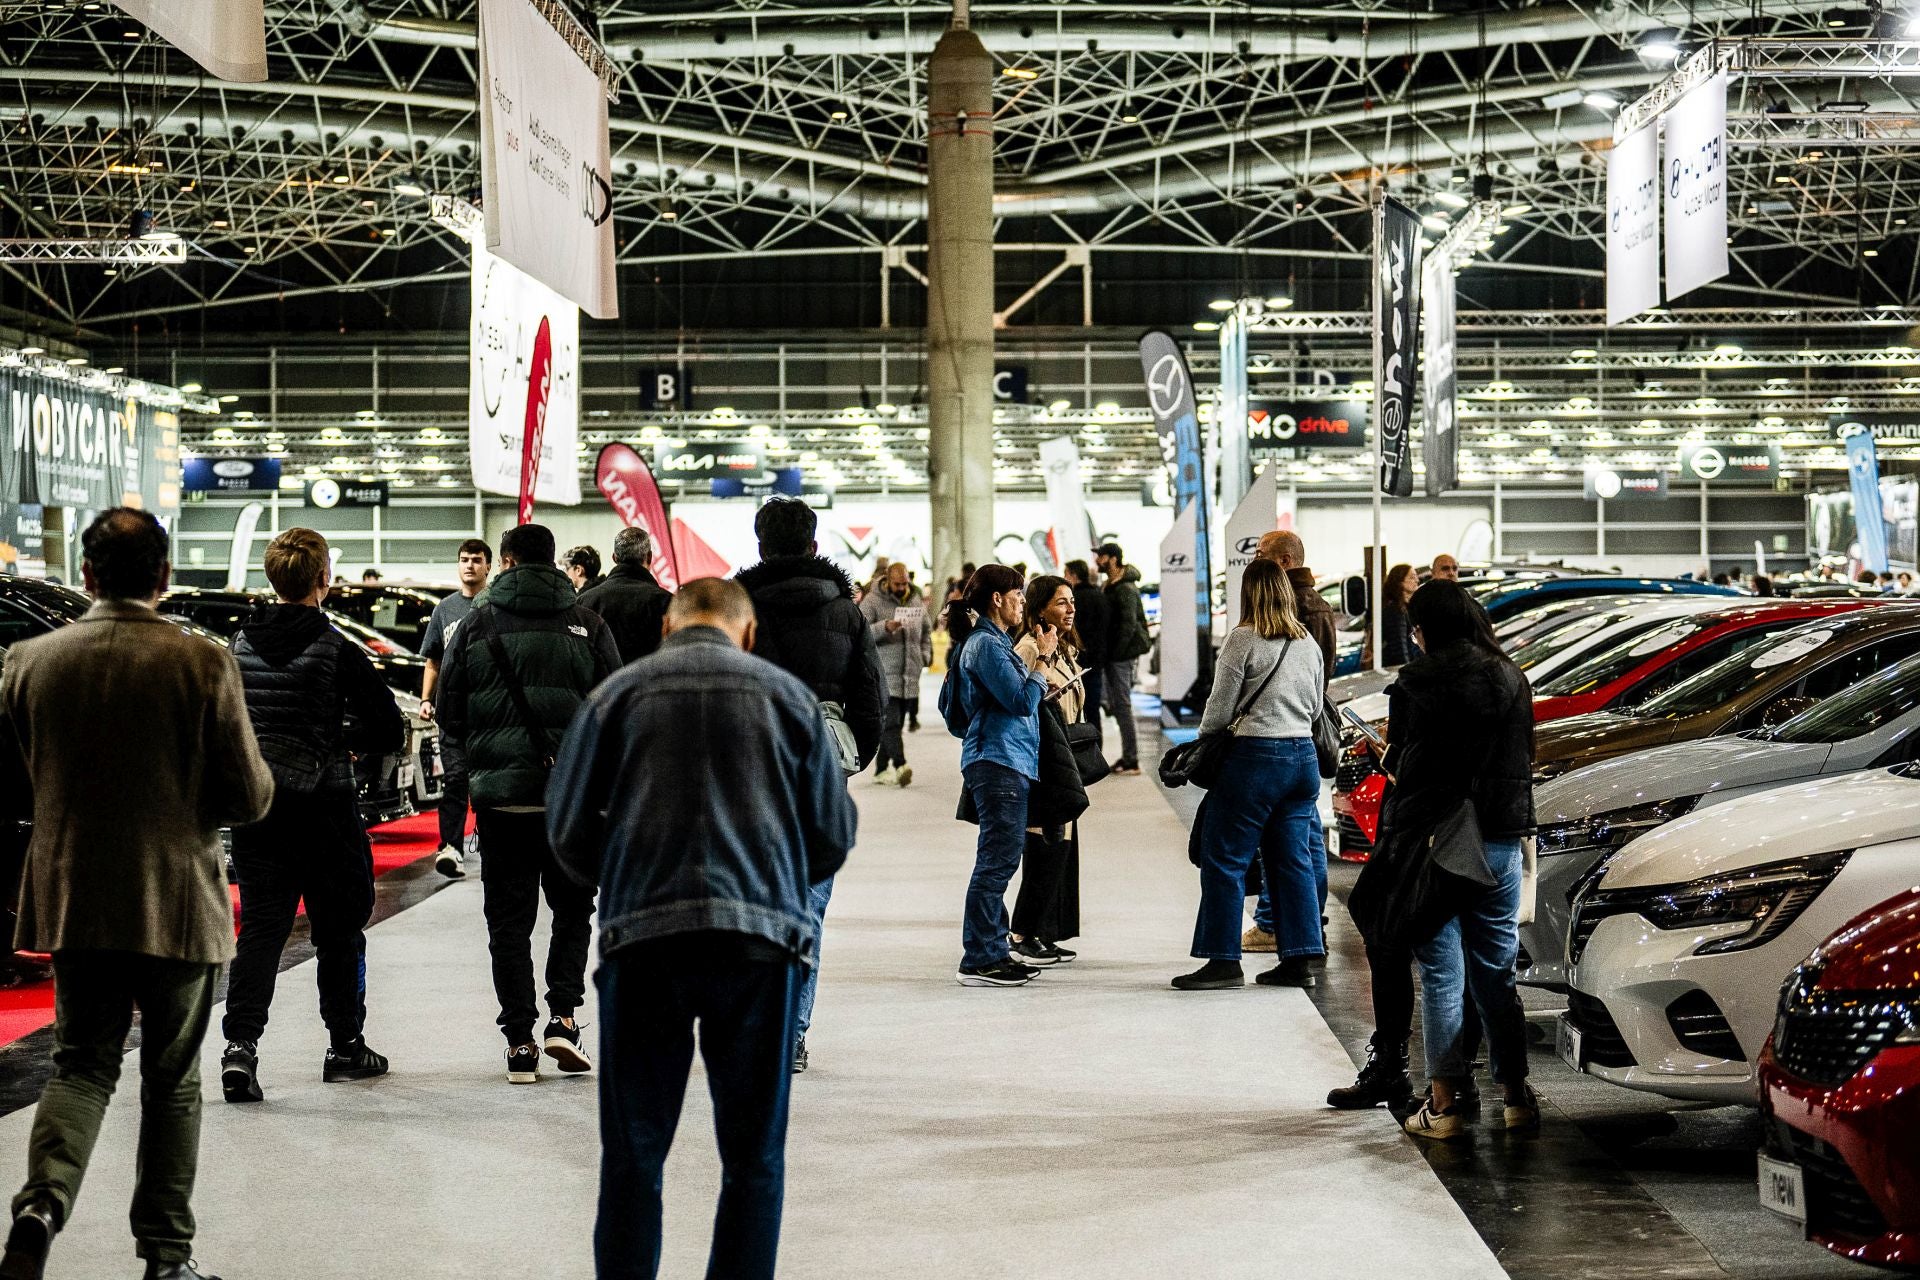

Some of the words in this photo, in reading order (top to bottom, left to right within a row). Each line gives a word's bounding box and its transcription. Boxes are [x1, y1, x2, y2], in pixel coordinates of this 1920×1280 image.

[657, 374, 675, 400] B
[993, 371, 1012, 399] C
[1247, 410, 1297, 440] MO
[1300, 416, 1350, 434] drive
[1870, 424, 1919, 438] HYUN
[662, 453, 715, 471] KIA
[1772, 1172, 1796, 1208] new
